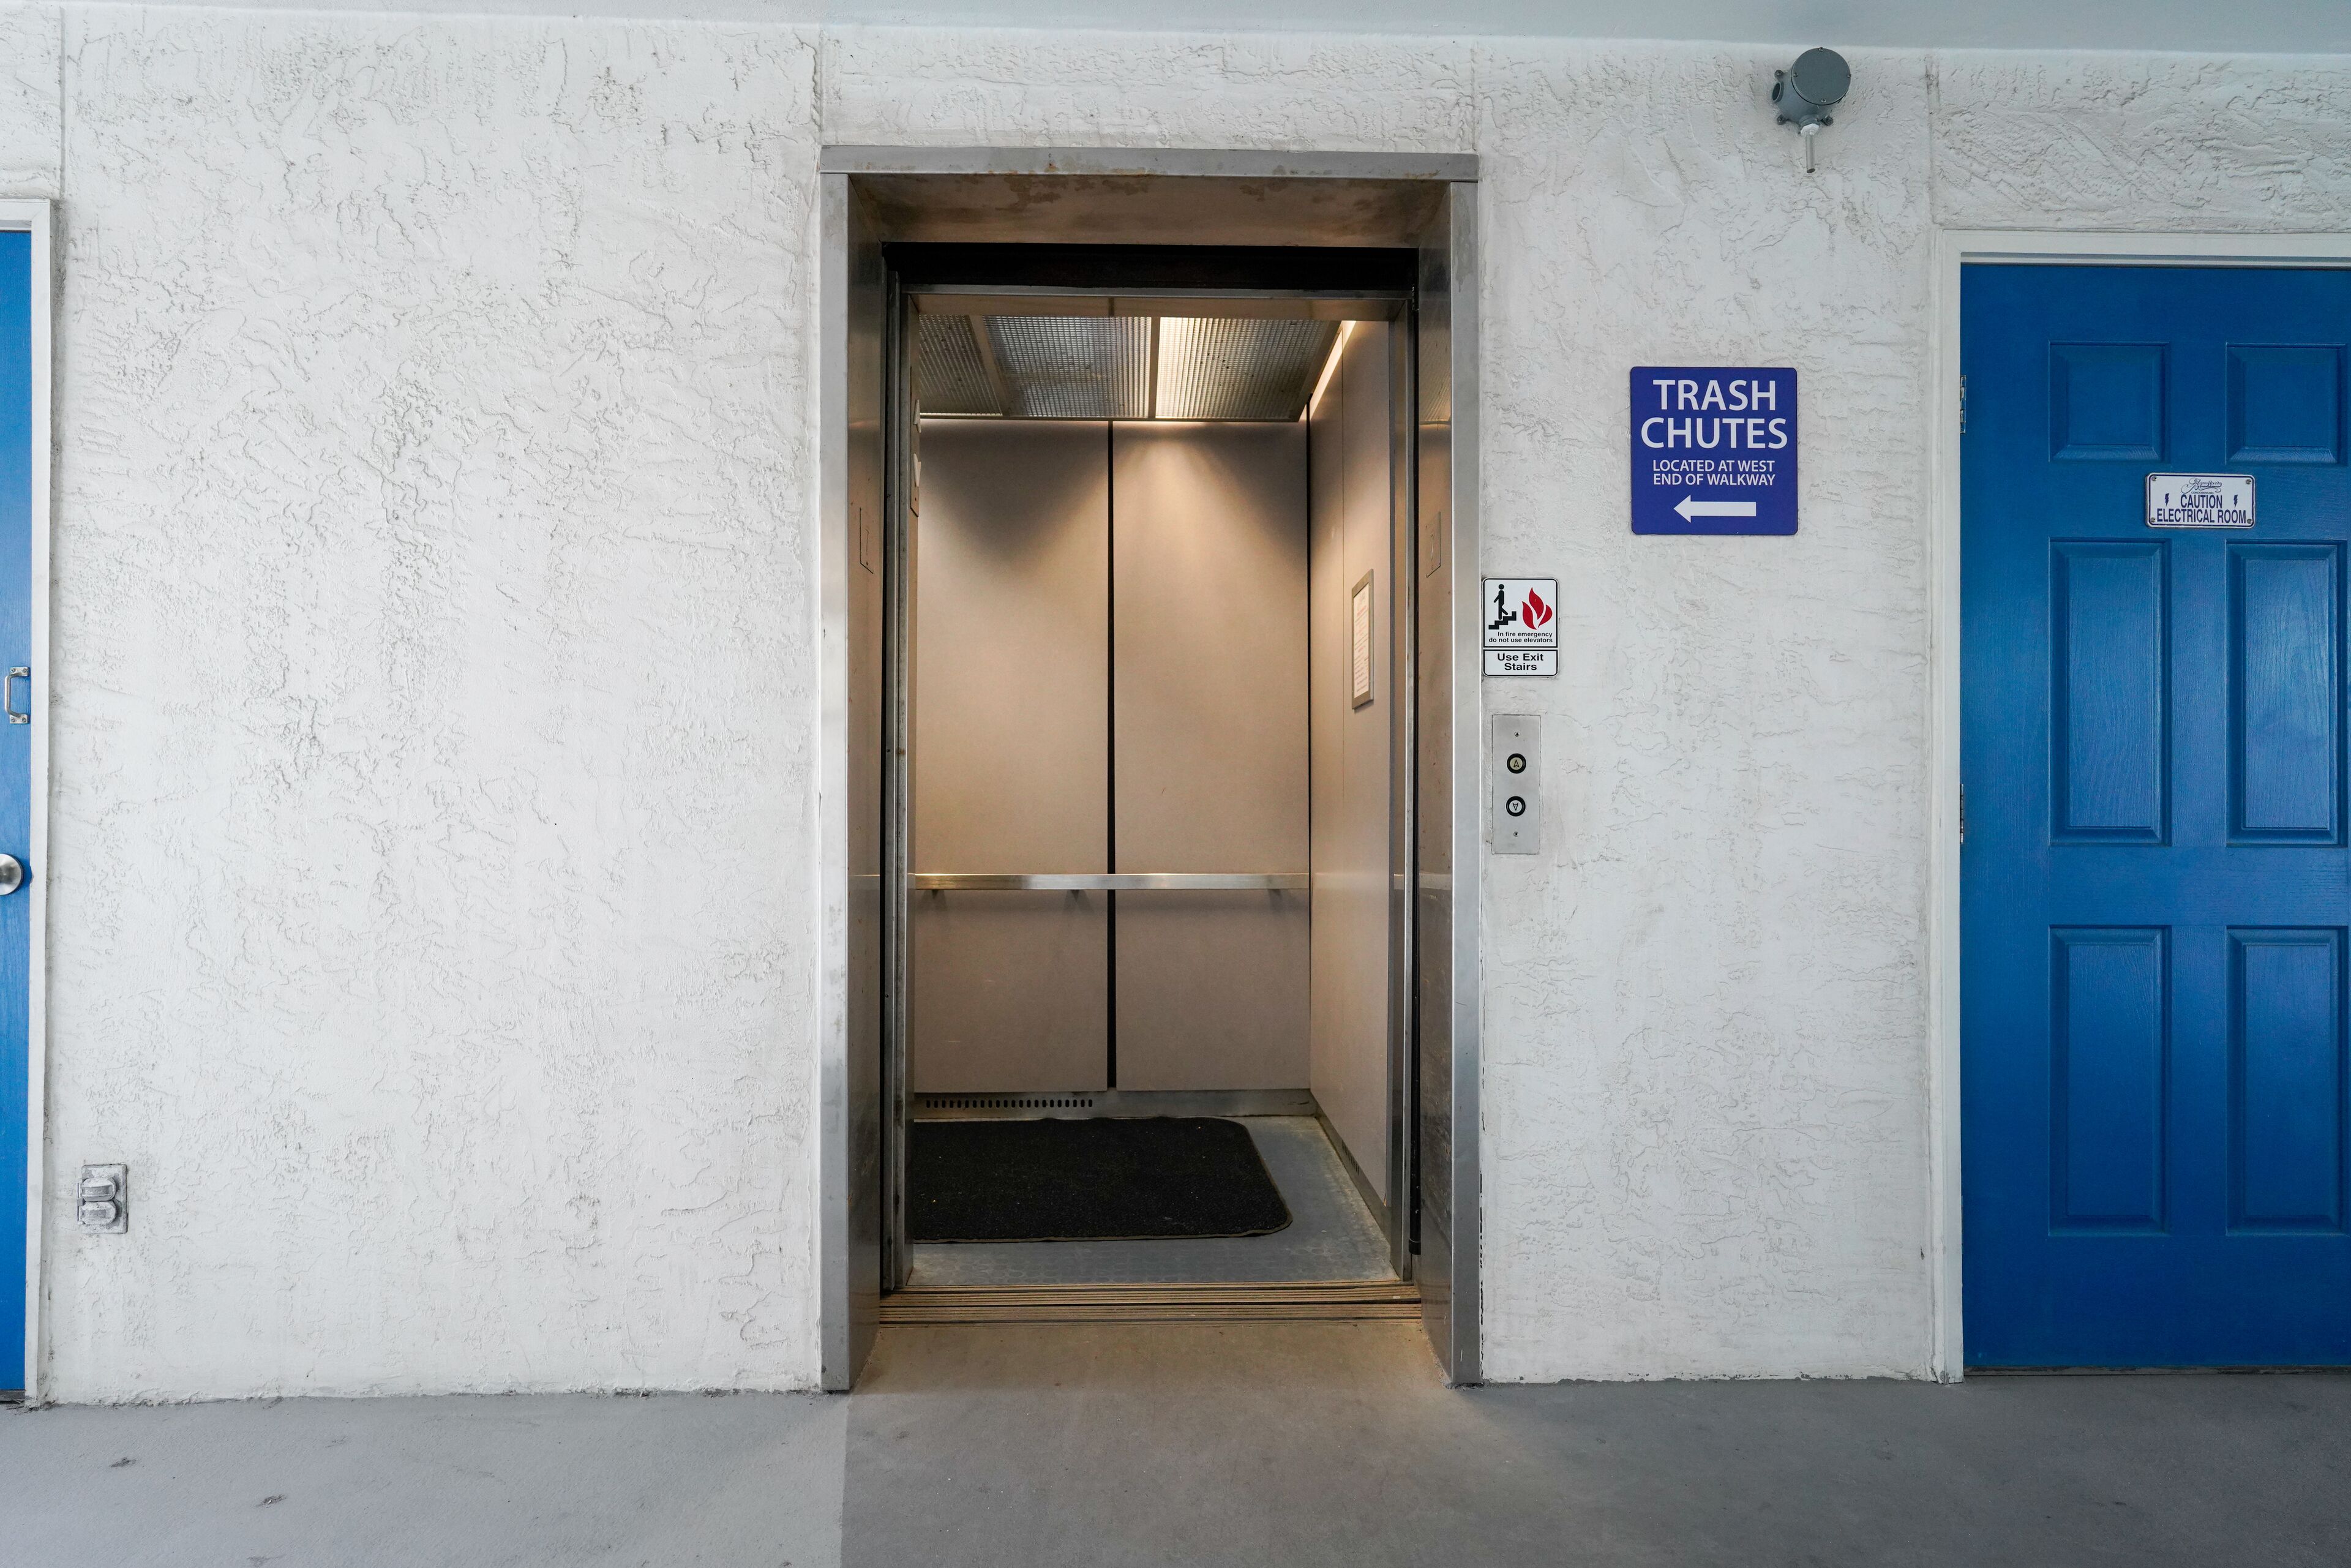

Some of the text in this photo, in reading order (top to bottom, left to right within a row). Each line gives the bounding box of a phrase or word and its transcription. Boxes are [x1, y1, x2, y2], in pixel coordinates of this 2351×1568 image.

[1653, 380, 1775, 411] TRASH
[1641, 417, 1788, 449] CHUTES
[1653, 459, 1775, 472] LOCATED AT WEST
[1654, 474, 1775, 486] END OF WALKWAY
[2180, 494, 2222, 509] CAUTION
[2157, 508, 2246, 523] ELECTRICAL ROOM
